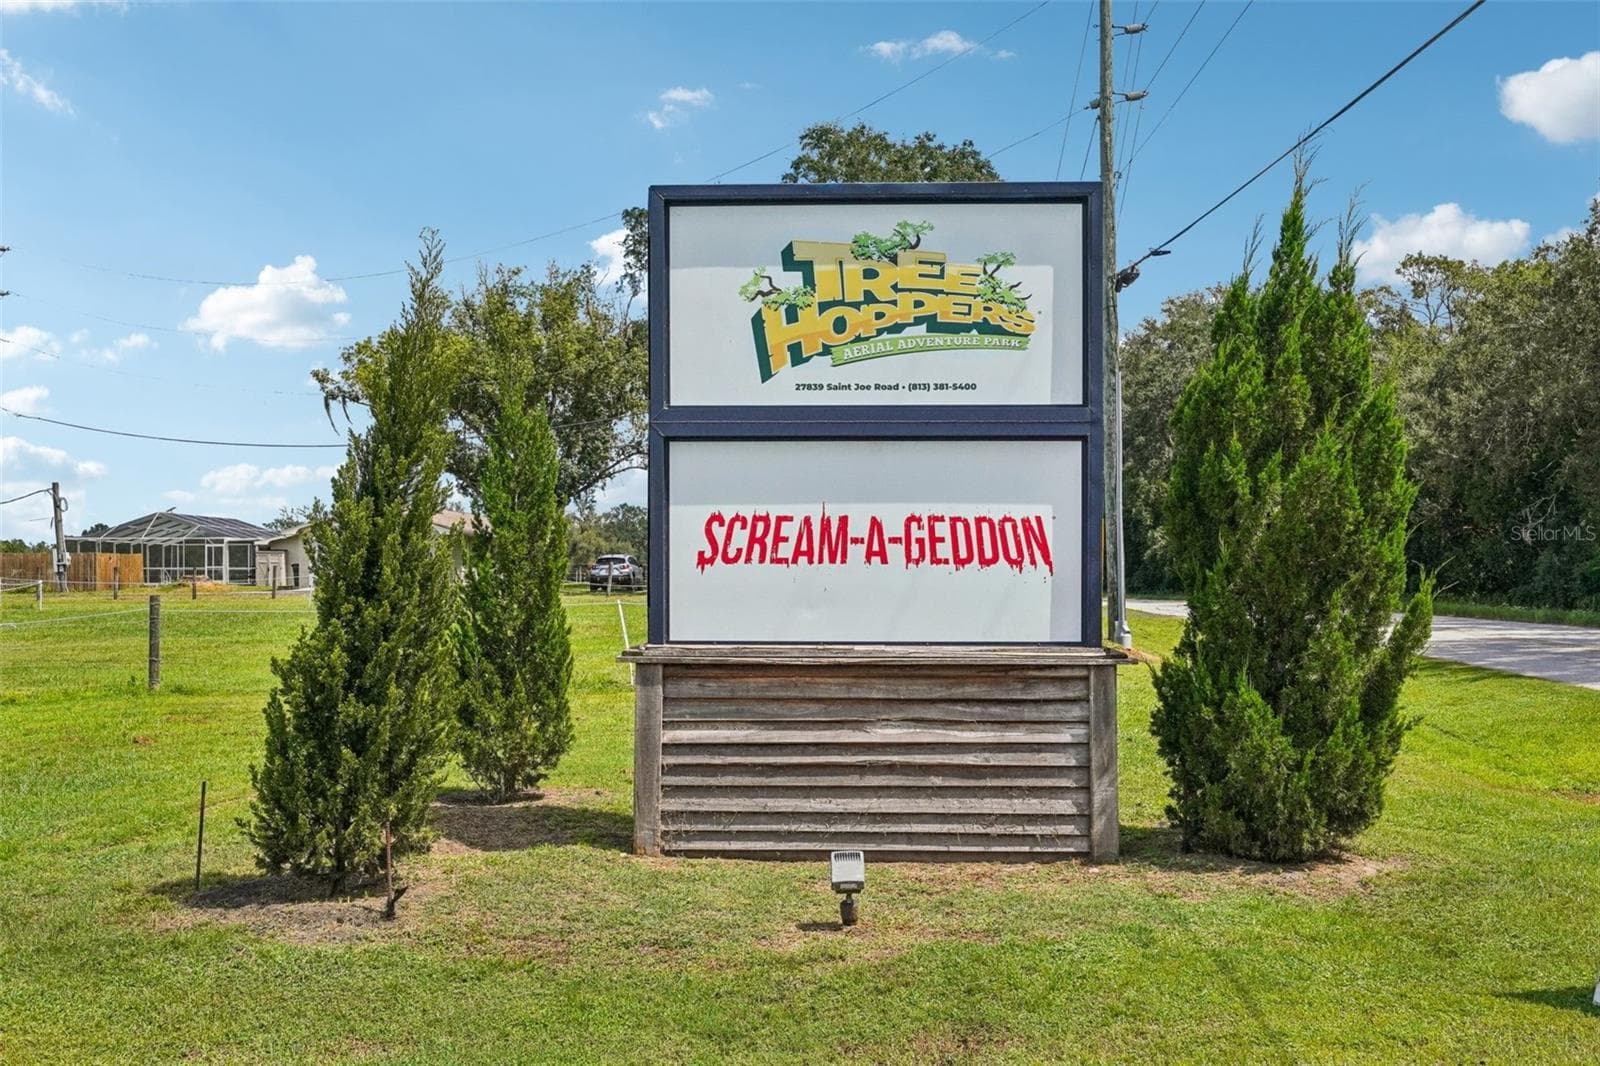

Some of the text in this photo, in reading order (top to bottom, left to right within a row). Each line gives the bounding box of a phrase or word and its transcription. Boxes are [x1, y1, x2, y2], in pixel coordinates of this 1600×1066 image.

[782, 240, 984, 303] TREE
[753, 292, 1036, 379] HOPPERS
[843, 336, 1021, 360] AERIAL ADVENTURE PARK
[795, 382, 977, 392] 27839 Saint Joe Road (813) 381-5400
[697, 504, 1053, 574] SCREAM-A-GEDDON
